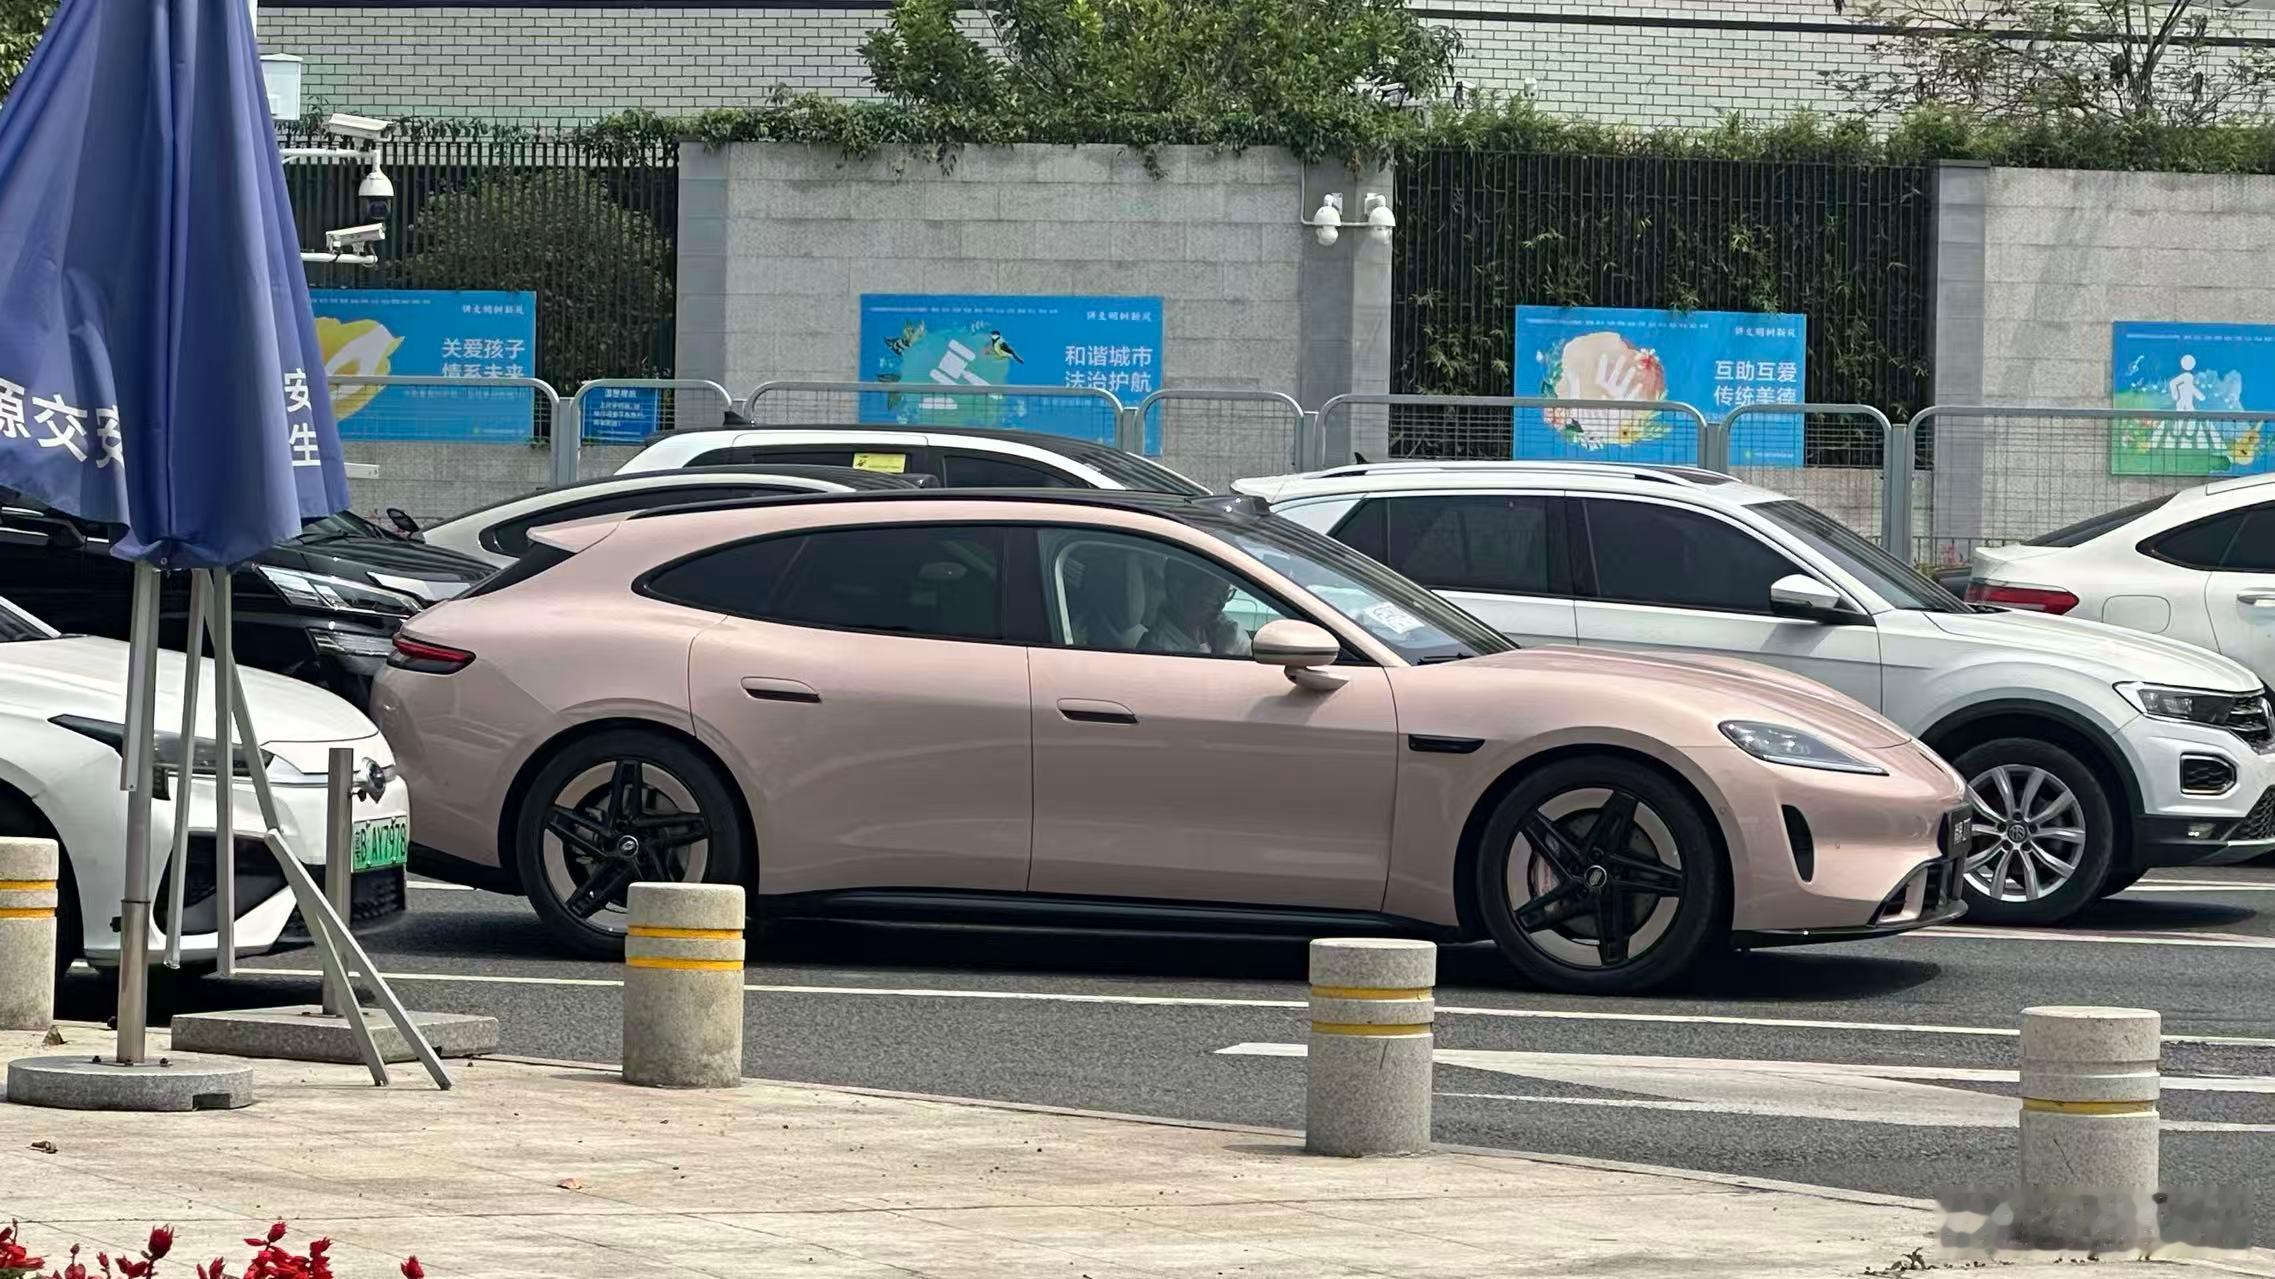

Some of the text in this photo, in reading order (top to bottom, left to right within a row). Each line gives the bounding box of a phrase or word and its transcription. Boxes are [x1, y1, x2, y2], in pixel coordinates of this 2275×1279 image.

[442, 338, 525, 359] 关爱孩子
[1065, 345, 1153, 367] 和谐城市
[442, 363, 525, 379] 情系未来
[1714, 360, 1797, 383] 互助互爱
[1064, 371, 1152, 394] 法治护航
[1714, 385, 1797, 406] 传统美德
